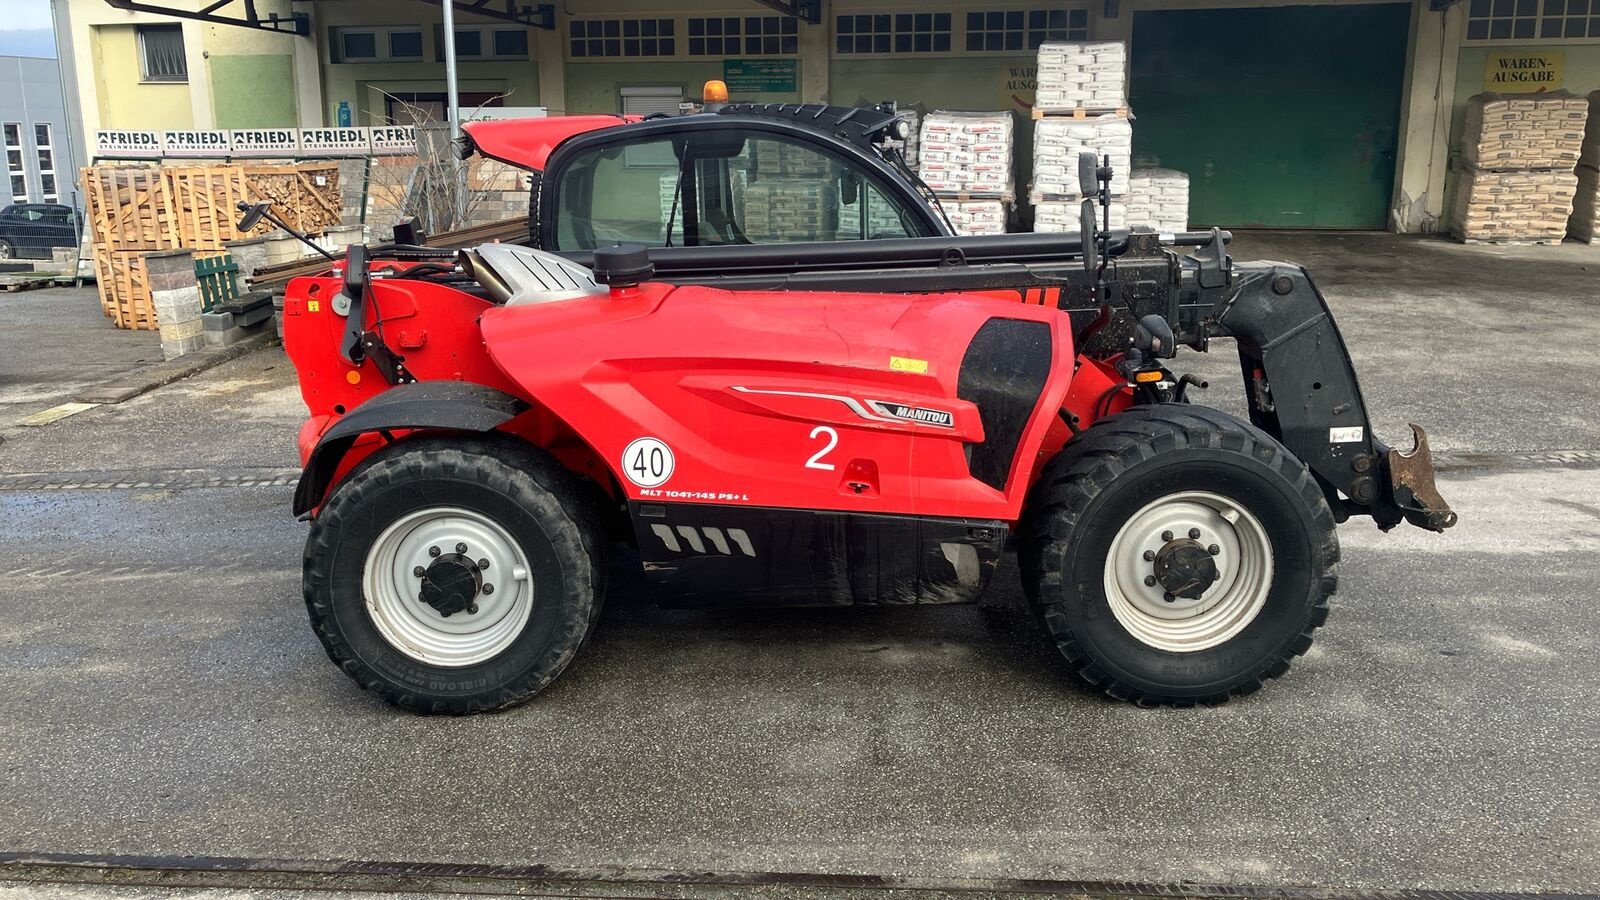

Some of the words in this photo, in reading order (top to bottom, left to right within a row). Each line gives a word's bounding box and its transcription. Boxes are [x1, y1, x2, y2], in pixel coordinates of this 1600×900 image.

[1499, 58, 1552, 69] WAREN-
[1009, 68, 1037, 78] WAR
[1493, 71, 1555, 82] AUSGABE
[1006, 80, 1037, 90] AUSG
[110, 132, 159, 144] FRIEDL
[178, 132, 227, 144] FRIEDL
[247, 131, 295, 143] FRIEDL
[315, 130, 365, 142] FRIEDL
[895, 406, 948, 423] MANITOU
[804, 425, 839, 471] 2
[633, 447, 664, 478] 40
[640, 488, 662, 497] MLT
[665, 490, 716, 499] 1041-145
